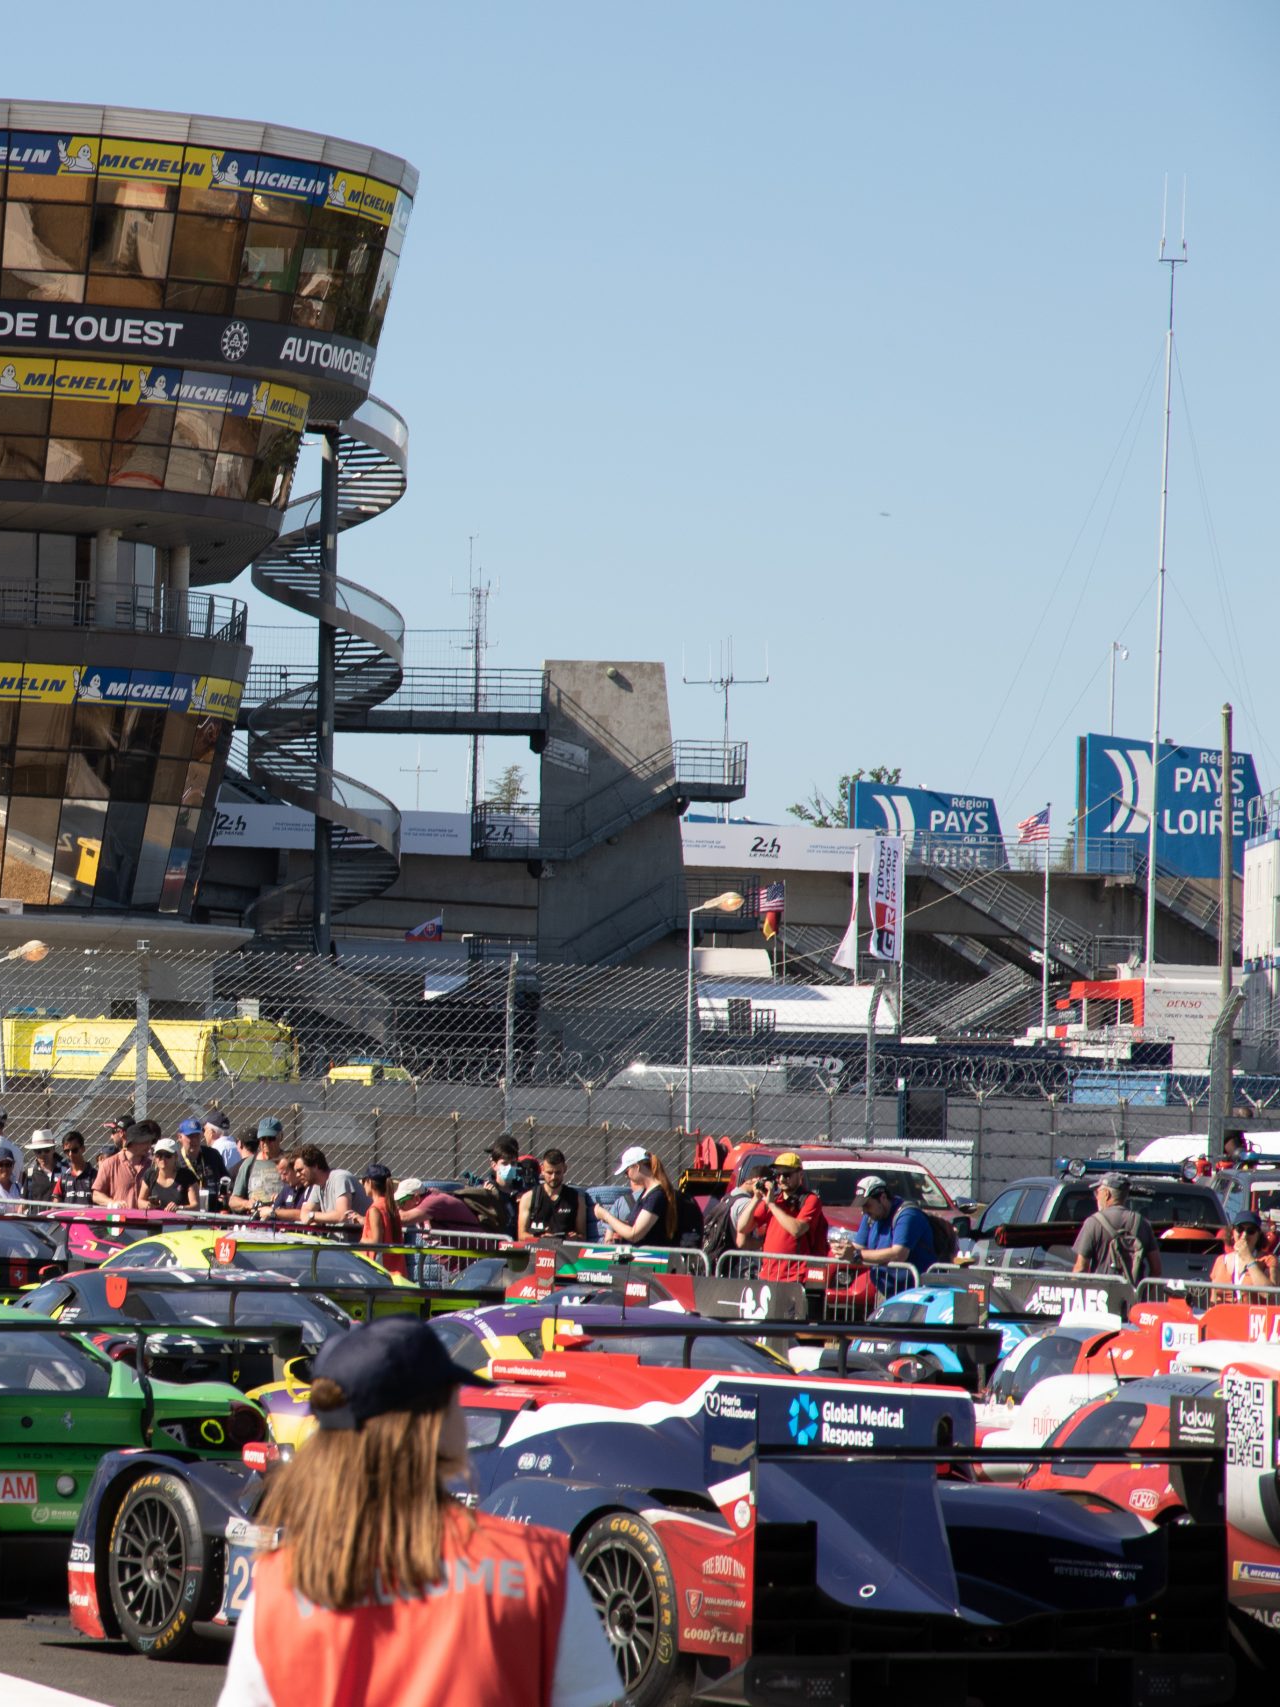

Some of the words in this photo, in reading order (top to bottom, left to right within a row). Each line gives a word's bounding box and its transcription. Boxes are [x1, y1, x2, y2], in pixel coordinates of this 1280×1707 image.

[99, 154, 205, 176] MICHELIN
[243, 169, 325, 195] MICHELIN
[348, 189, 394, 216] MICHELIN
[49, 314, 183, 347] L'OUEST
[280, 337, 372, 380] AUTOMOBILE
[24, 373, 133, 392] MICHELIN
[171, 383, 250, 405] MICHELIN
[106, 681, 188, 701] MICHELIN
[1175, 767, 1244, 794] PAYS
[952, 798, 989, 810] Région
[930, 810, 989, 833] PAYS
[1164, 810, 1244, 836] LOIRE
[921, 845, 988, 868] LOIRE
[875, 840, 885, 898] TOYOTA
[1166, 1000, 1202, 1008] DENSO
[536, 1257, 555, 1268] JOTA
[626, 1283, 647, 1297] MOTUL
[1039, 1286, 1063, 1301] FEAR
[1176, 1332, 1197, 1346] JFE
[822, 1401, 858, 1424] Global
[860, 1404, 904, 1429] Medical
[1179, 1399, 1215, 1428] halow
[822, 1423, 874, 1447] Response
[244, 1451, 266, 1463] MOTUL
[1, 1477, 35, 1500] AM
[70, 1548, 90, 1562] AERO
[702, 1559, 714, 1575] THE
[715, 1555, 732, 1574] BOOT
[733, 1556, 746, 1579] INN
[683, 1626, 745, 1645] GOODYEAR
